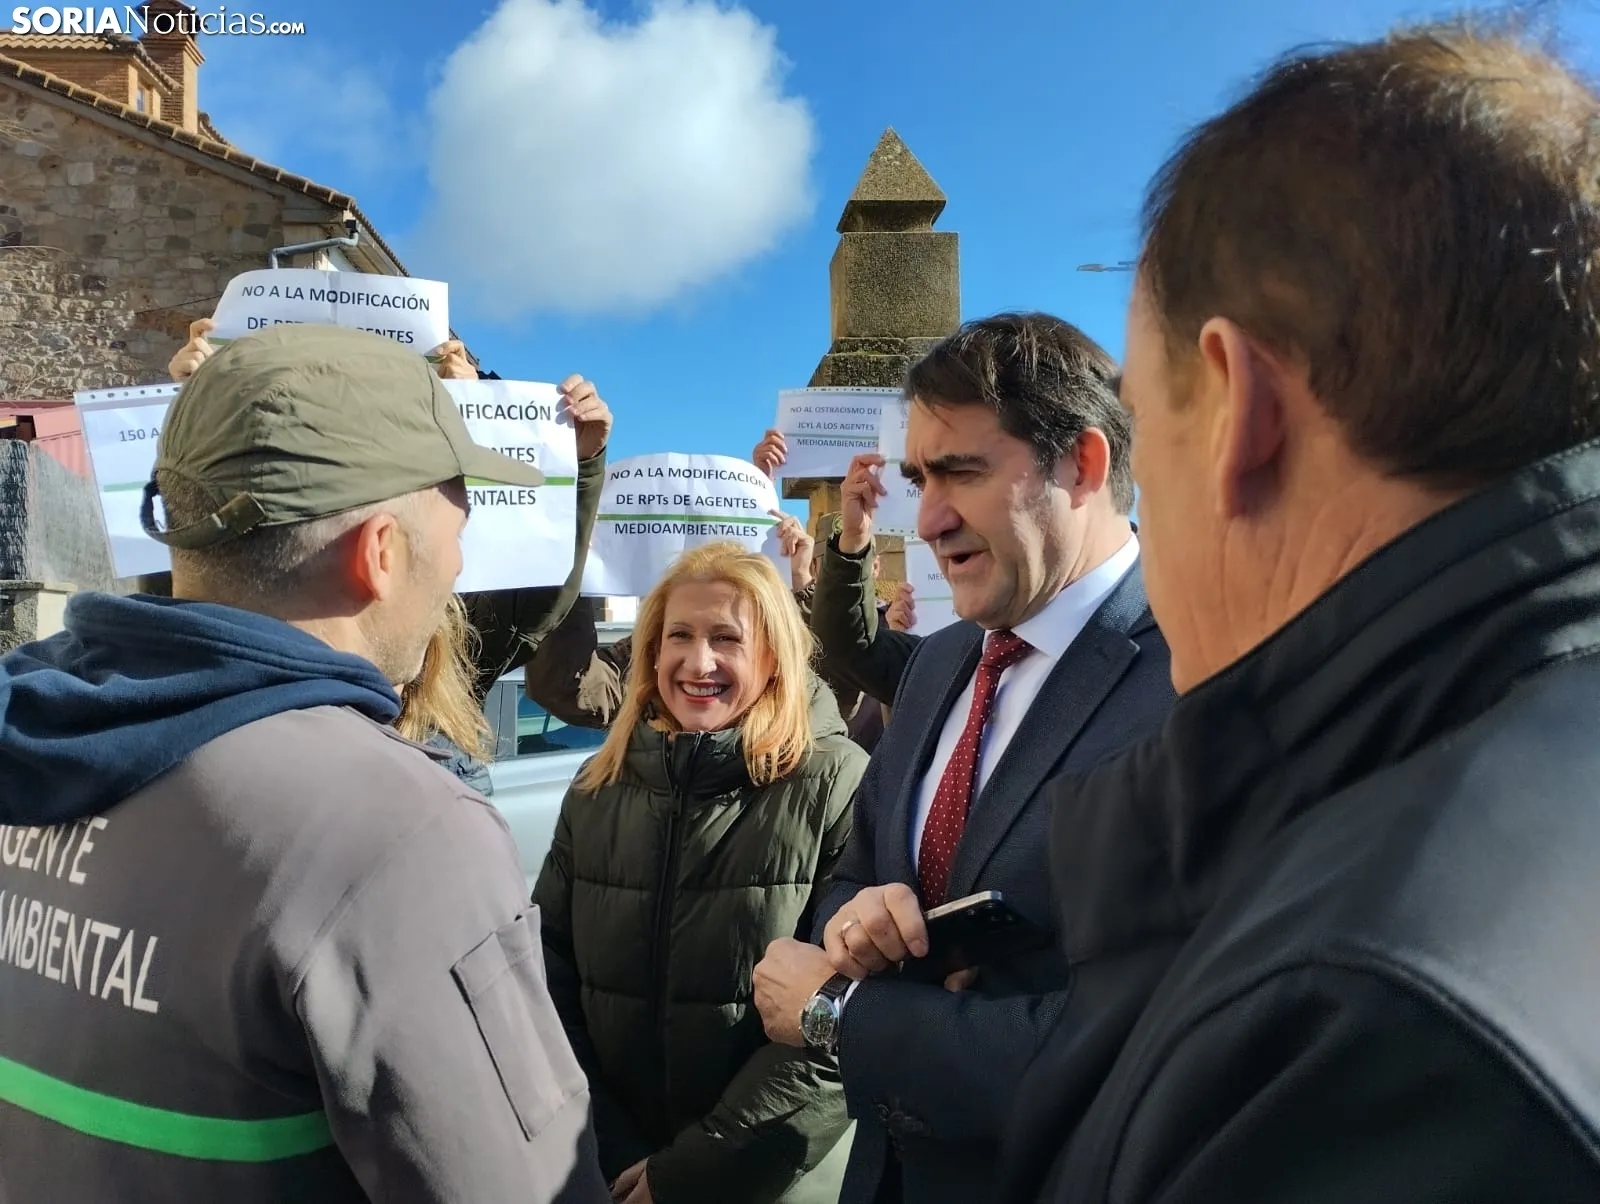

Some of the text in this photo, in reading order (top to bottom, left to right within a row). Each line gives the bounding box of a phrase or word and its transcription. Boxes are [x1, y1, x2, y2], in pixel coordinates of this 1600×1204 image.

[242, 285, 430, 311] NO A LA MODIFICACIÓN
[459, 400, 551, 421] IFICACIÓN
[814, 406, 866, 415] OSTRACISMO
[867, 407, 879, 415] DE
[823, 422, 838, 430] LOS
[839, 423, 875, 431] AGENTES
[119, 428, 146, 443] 150
[796, 438, 876, 448] MEDIOAMBIENTALES
[610, 467, 767, 490] NO A LA MODIFICACIÓN
[616, 494, 757, 509] DE RPTs DE AGENTES
[614, 522, 758, 537] MEDIOAMBIENTALES
